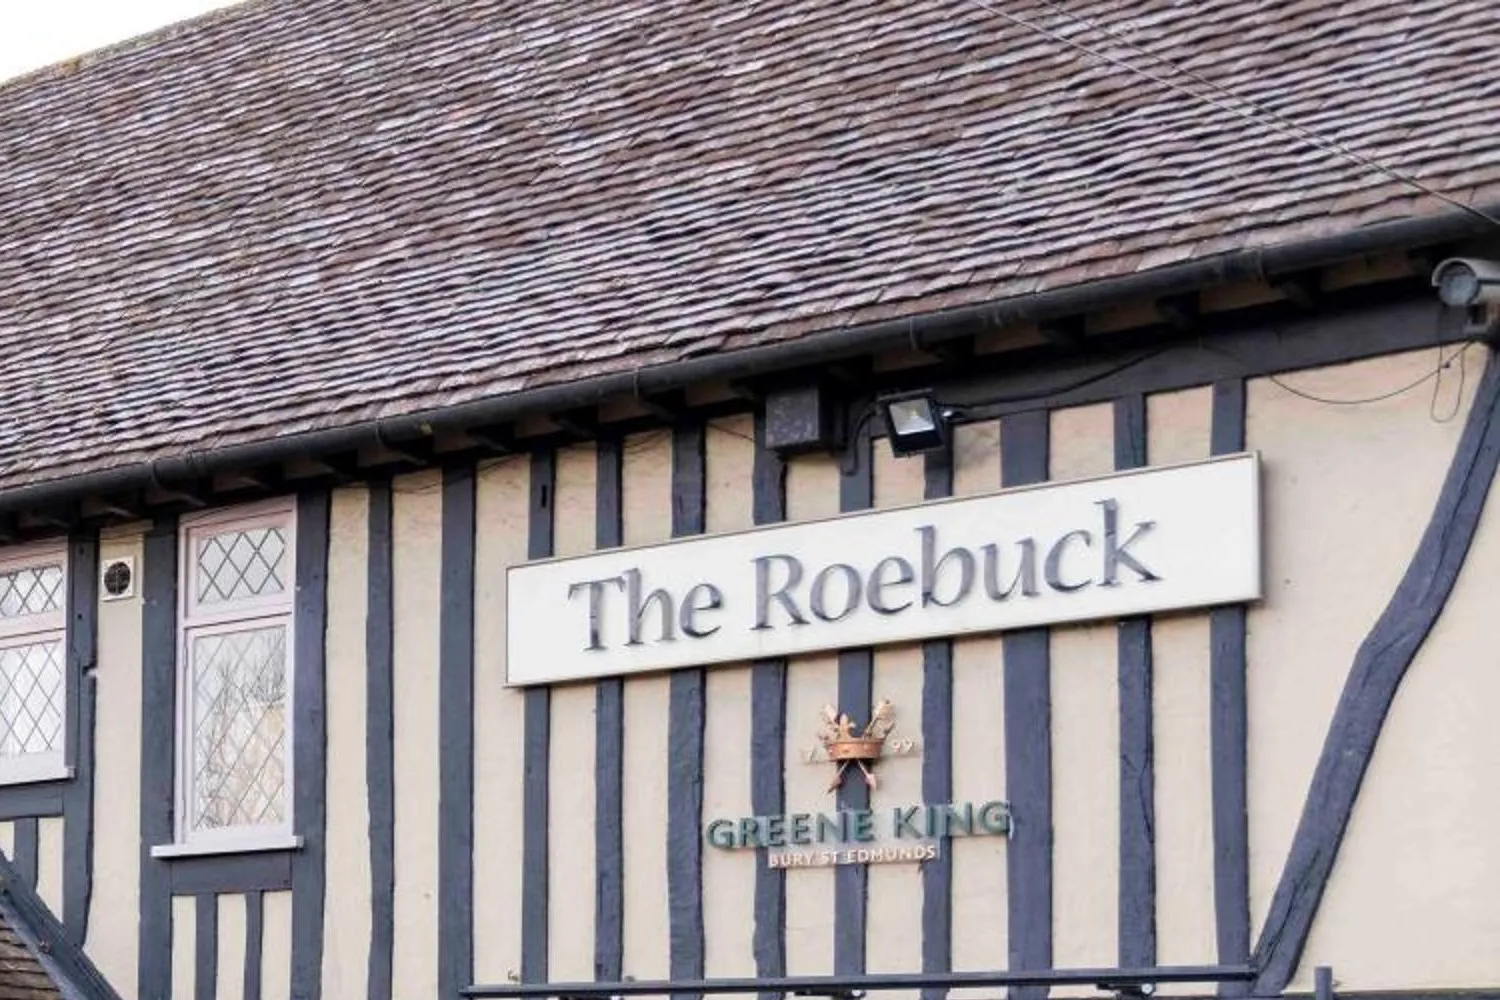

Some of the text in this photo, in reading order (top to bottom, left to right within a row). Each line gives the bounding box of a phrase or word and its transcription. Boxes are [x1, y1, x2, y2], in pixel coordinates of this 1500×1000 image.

[566, 497, 1163, 651] The Roebuck
[705, 800, 1011, 850] GREENE KING
[768, 845, 936, 868] BURY ST EDMUNDS
